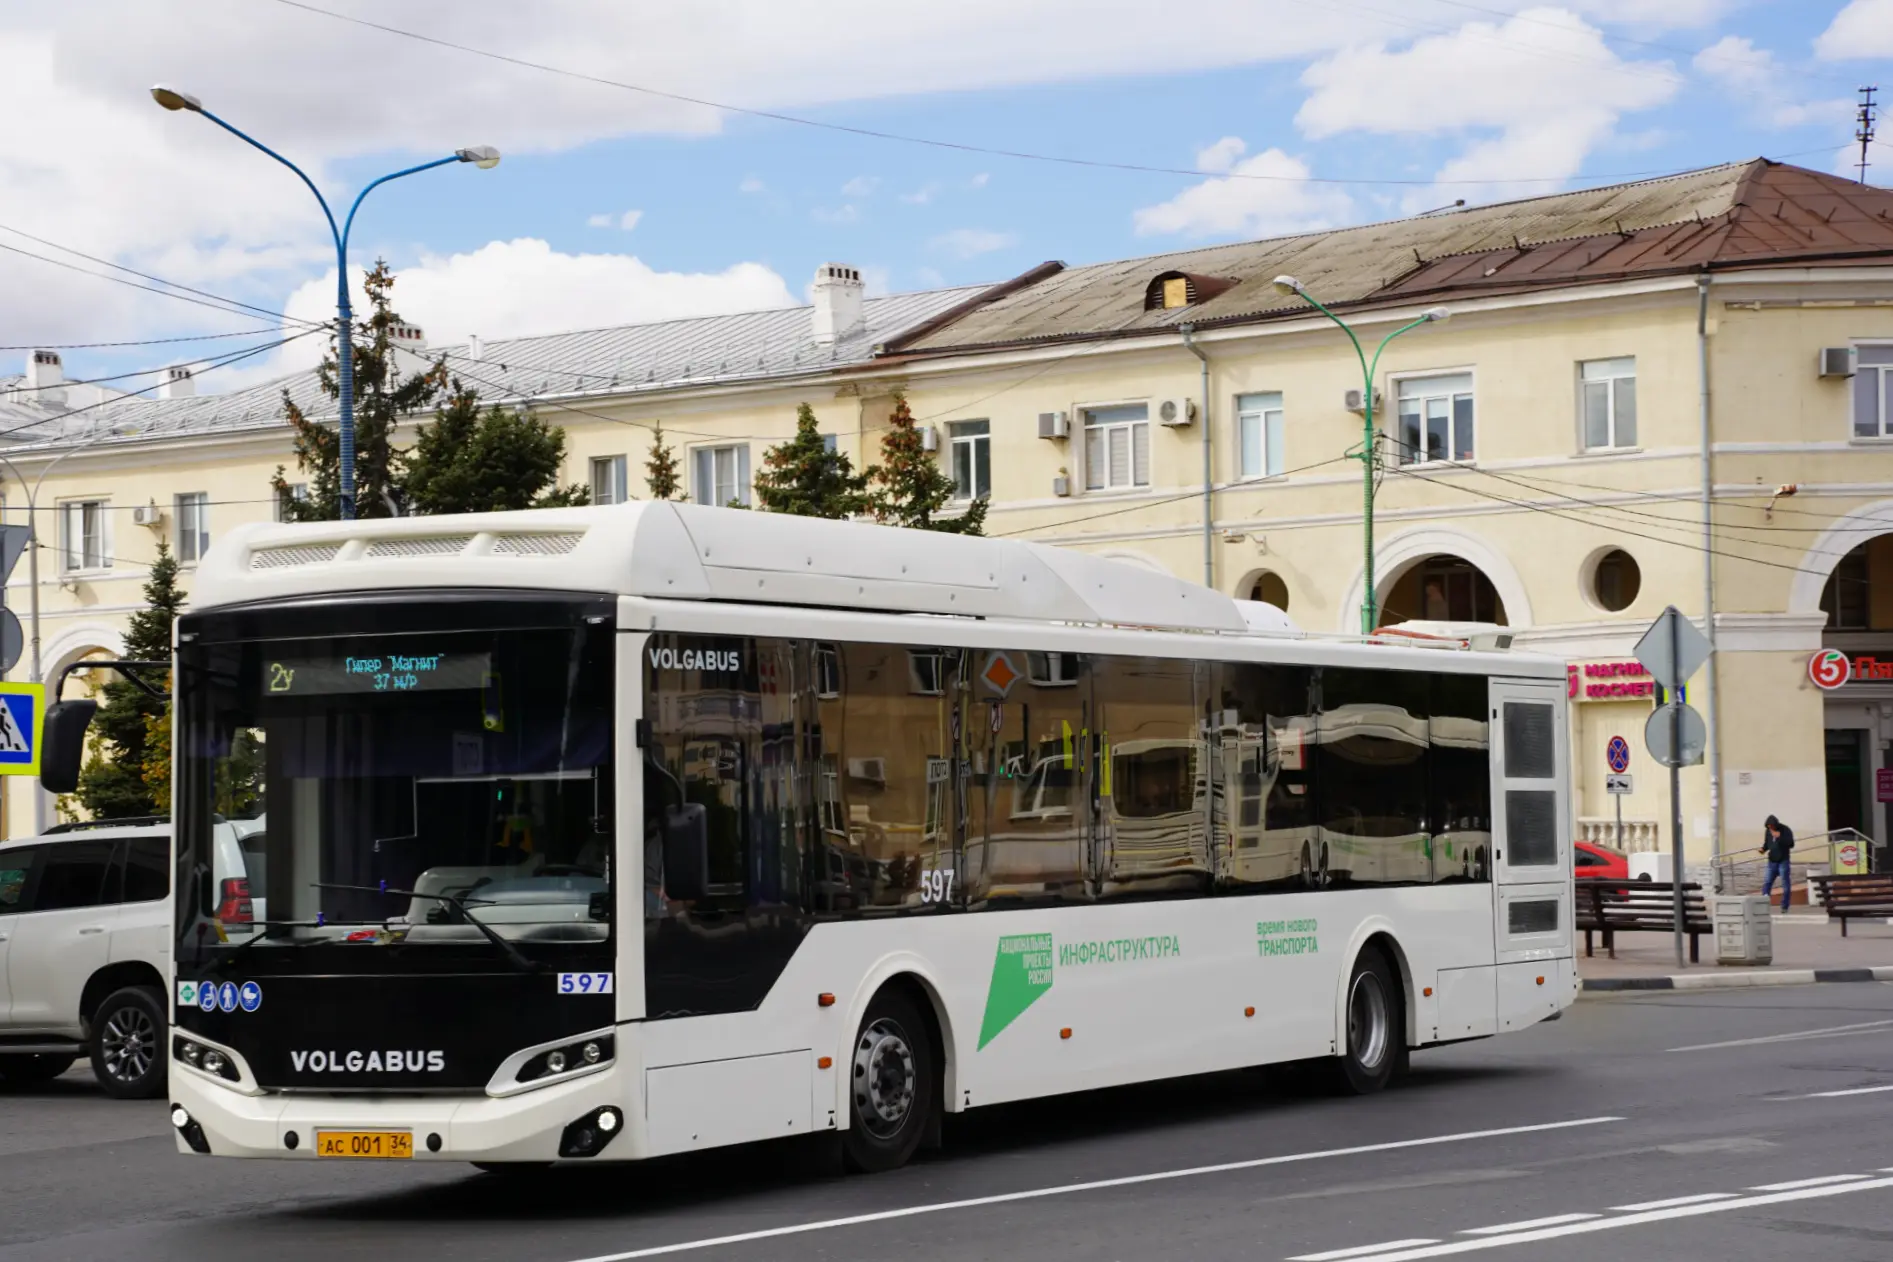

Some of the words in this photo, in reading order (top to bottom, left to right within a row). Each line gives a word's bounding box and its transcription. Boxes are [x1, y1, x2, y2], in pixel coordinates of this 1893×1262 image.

[649, 648, 740, 671] VOLGABUS
[373, 673, 390, 690] 37
[921, 869, 955, 903] 597
[1059, 935, 1181, 966] ИНФРАСТРУКТУРА
[1258, 936, 1319, 957] ТРАНСПОРТА
[561, 973, 609, 993] 597
[290, 1050, 445, 1072] VOLGABUS
[351, 1135, 381, 1154] 001
[391, 1135, 407, 1149] 34
